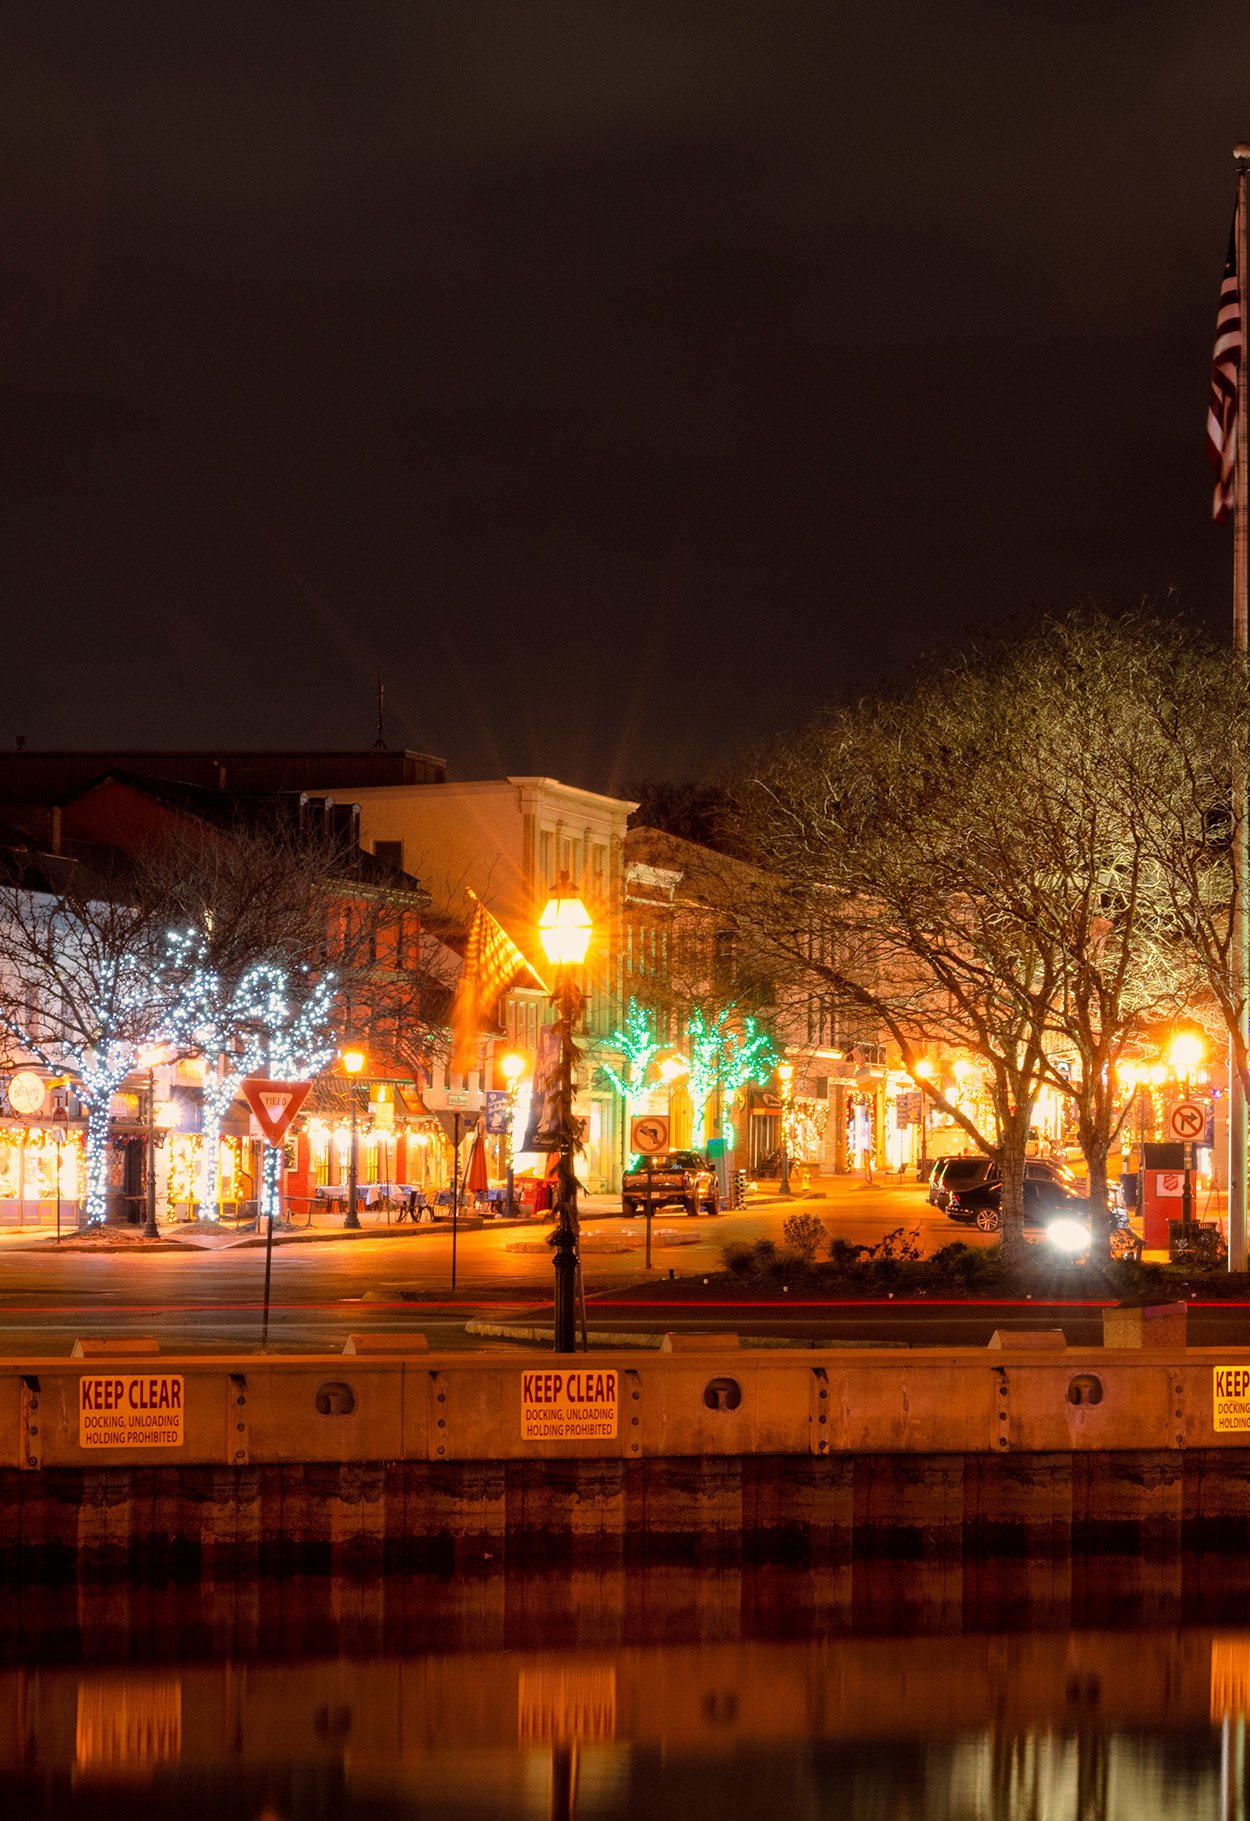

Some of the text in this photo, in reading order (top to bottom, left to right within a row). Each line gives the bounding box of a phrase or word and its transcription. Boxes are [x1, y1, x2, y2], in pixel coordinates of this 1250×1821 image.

[265, 1097, 287, 1106] YIELD
[524, 1374, 615, 1403] KEEP CLEAR
[1216, 1371, 1250, 1397] KEEP
[82, 1379, 181, 1410] KEEP CLEAR
[84, 1415, 179, 1429] DOCKING, UNLOADING
[526, 1408, 614, 1422] DOCKING, UNLOADING
[527, 1423, 612, 1436] HOLDING PROHIBITED
[1219, 1417, 1250, 1428] HOLDING
[86, 1431, 178, 1444] HOLDING PROHIBITED
